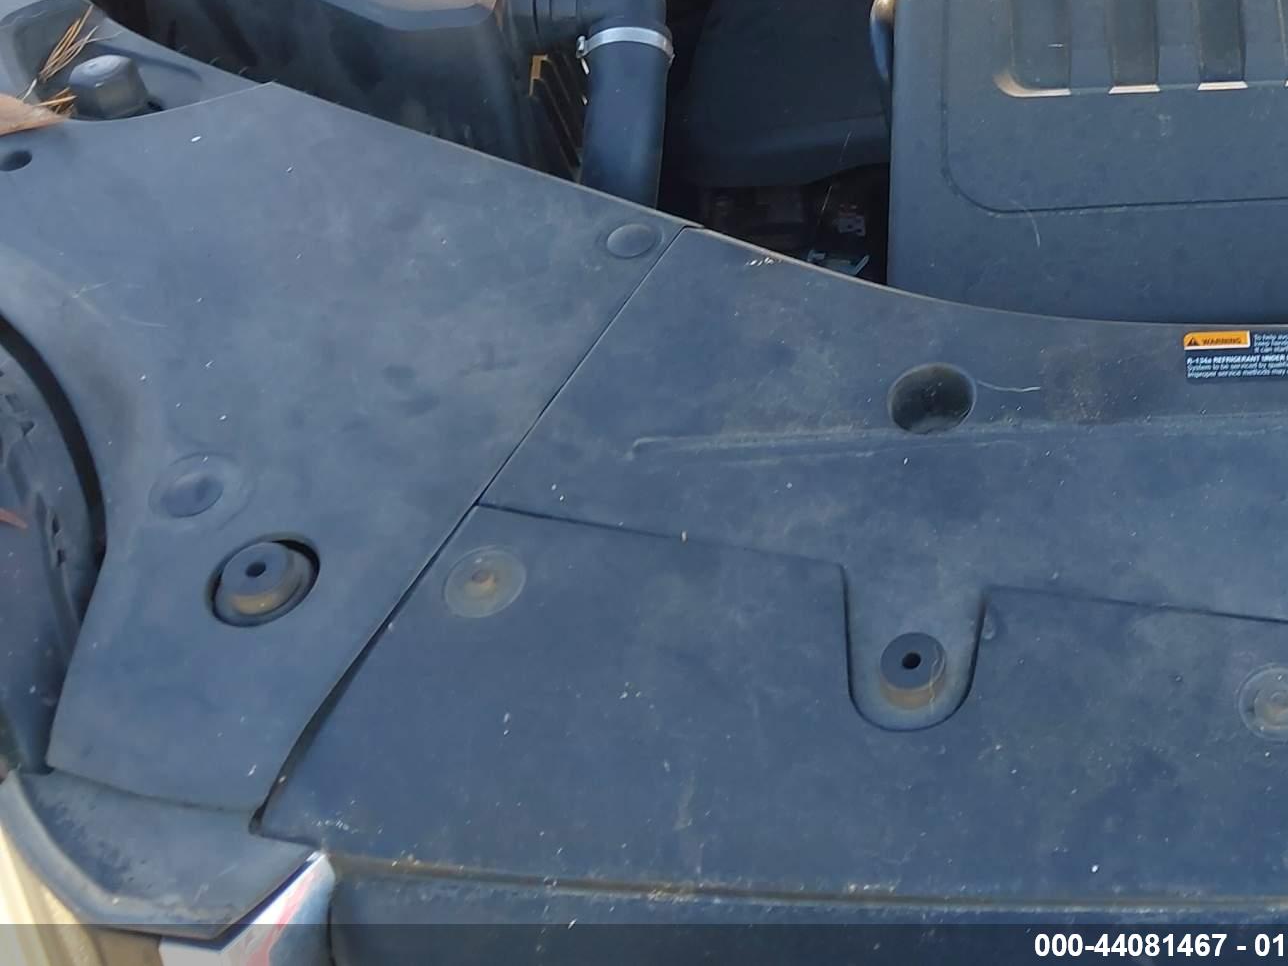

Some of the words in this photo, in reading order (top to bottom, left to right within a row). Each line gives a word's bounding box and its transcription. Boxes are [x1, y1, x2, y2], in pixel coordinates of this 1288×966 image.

[1203, 337, 1242, 345] WARNING
[1213, 355, 1260, 363] REFRIGERANT
[1261, 354, 1285, 362] UNDER
